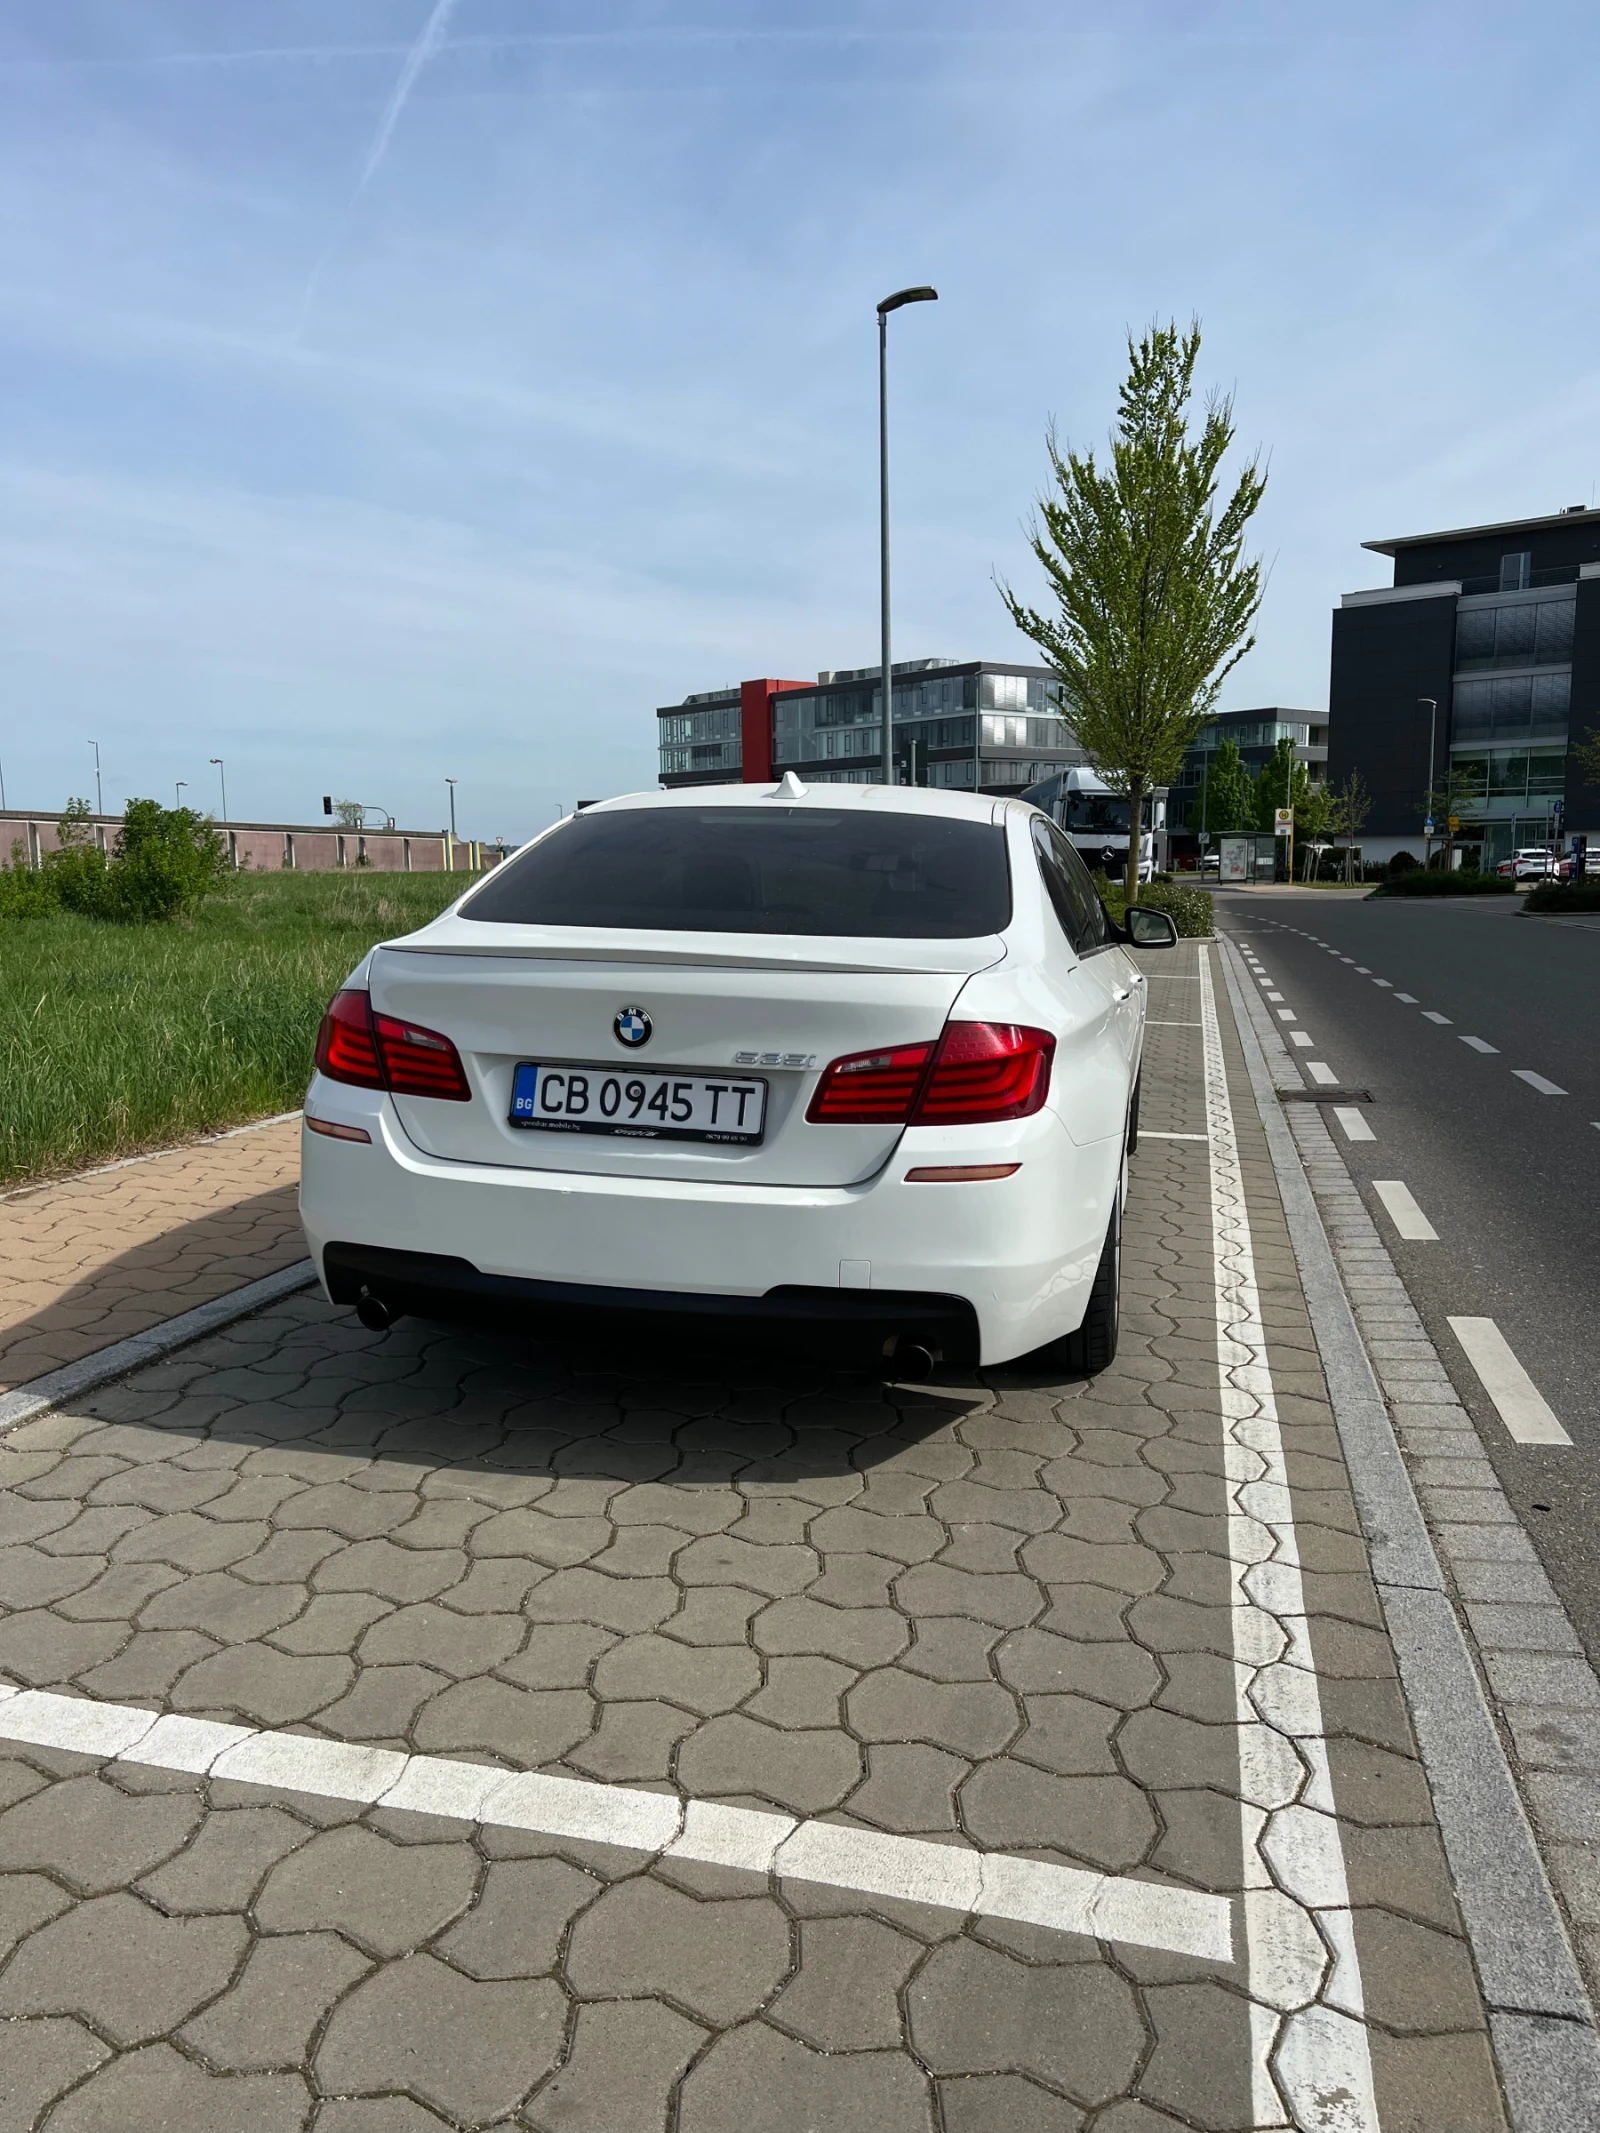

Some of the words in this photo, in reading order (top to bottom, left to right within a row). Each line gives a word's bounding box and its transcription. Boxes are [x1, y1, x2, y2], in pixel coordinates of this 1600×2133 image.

[616, 1008, 650, 1023] BMW
[735, 1050, 817, 1068] 535i
[516, 1097, 533, 1110] BG
[541, 1074, 589, 1114] CB
[600, 1078, 693, 1123] 0945
[705, 1084, 756, 1127] TT
